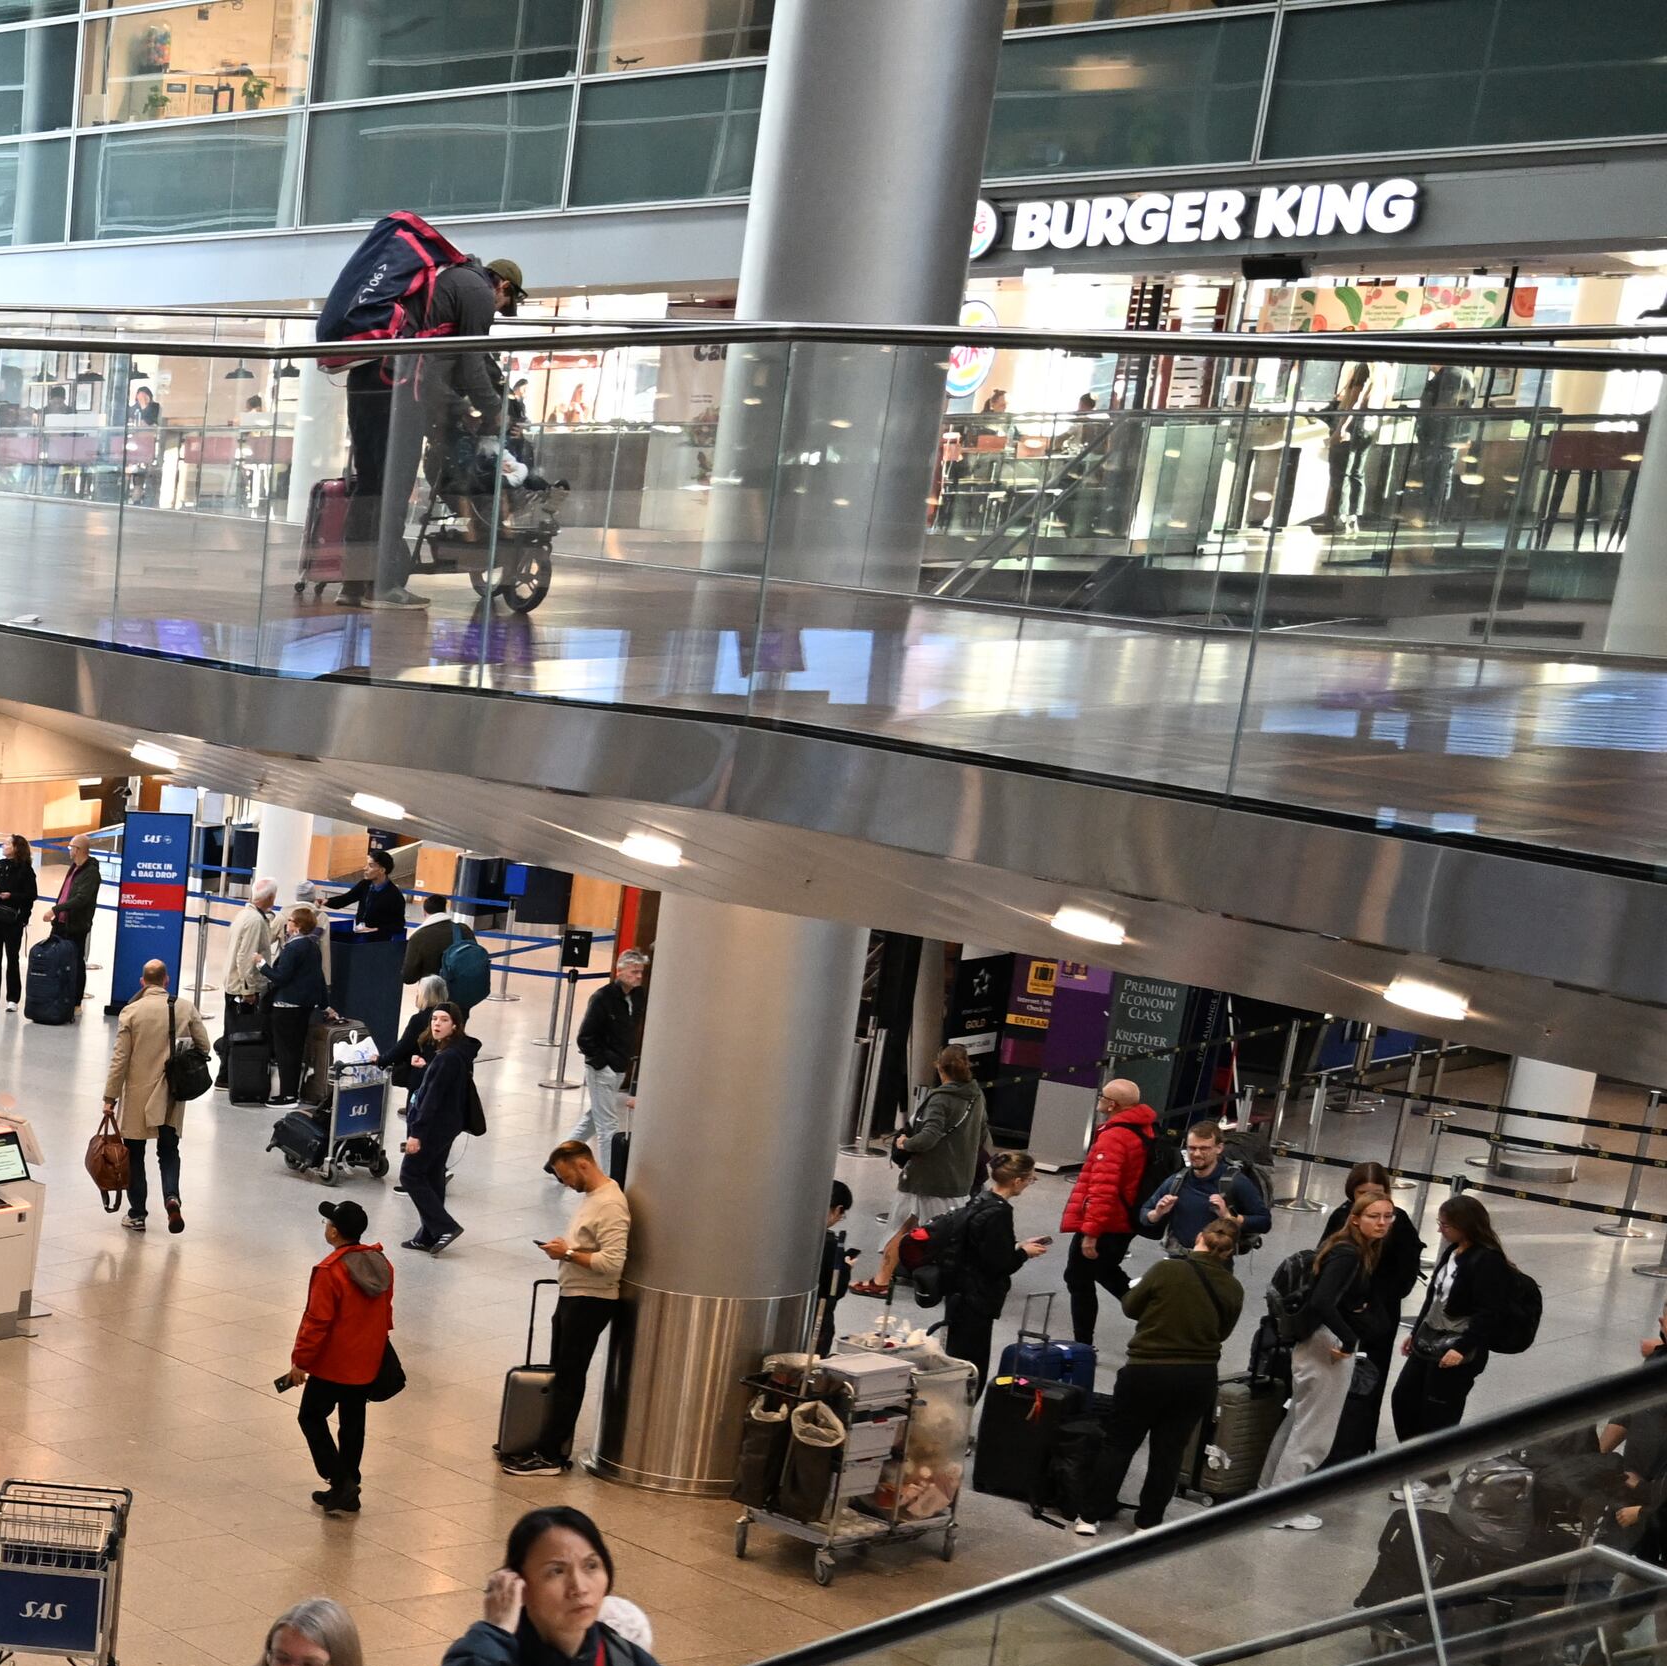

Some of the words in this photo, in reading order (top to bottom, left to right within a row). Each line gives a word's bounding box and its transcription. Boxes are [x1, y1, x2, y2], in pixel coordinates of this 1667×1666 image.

[1011, 190, 1247, 251] BURGER
[1253, 178, 1419, 239] KING
[142, 834, 163, 844] SAS
[136, 862, 162, 870] CHECK
[138, 870, 154, 878] BAG
[155, 871, 178, 879] DROP
[1124, 979, 1178, 998] PREMIUM
[1017, 996, 1040, 1006] Internet
[1119, 992, 1176, 1011] ECONOMY
[1128, 1007, 1163, 1023] CLASS
[1202, 998, 1219, 1040] ALLIANCE
[965, 1018, 986, 1029] GOLD
[1115, 1029, 1168, 1048] KRISFLYER
[1107, 1041, 1134, 1056] ELITE
[349, 1103, 370, 1117] SAS
[18, 1601, 68, 1621] SAS
